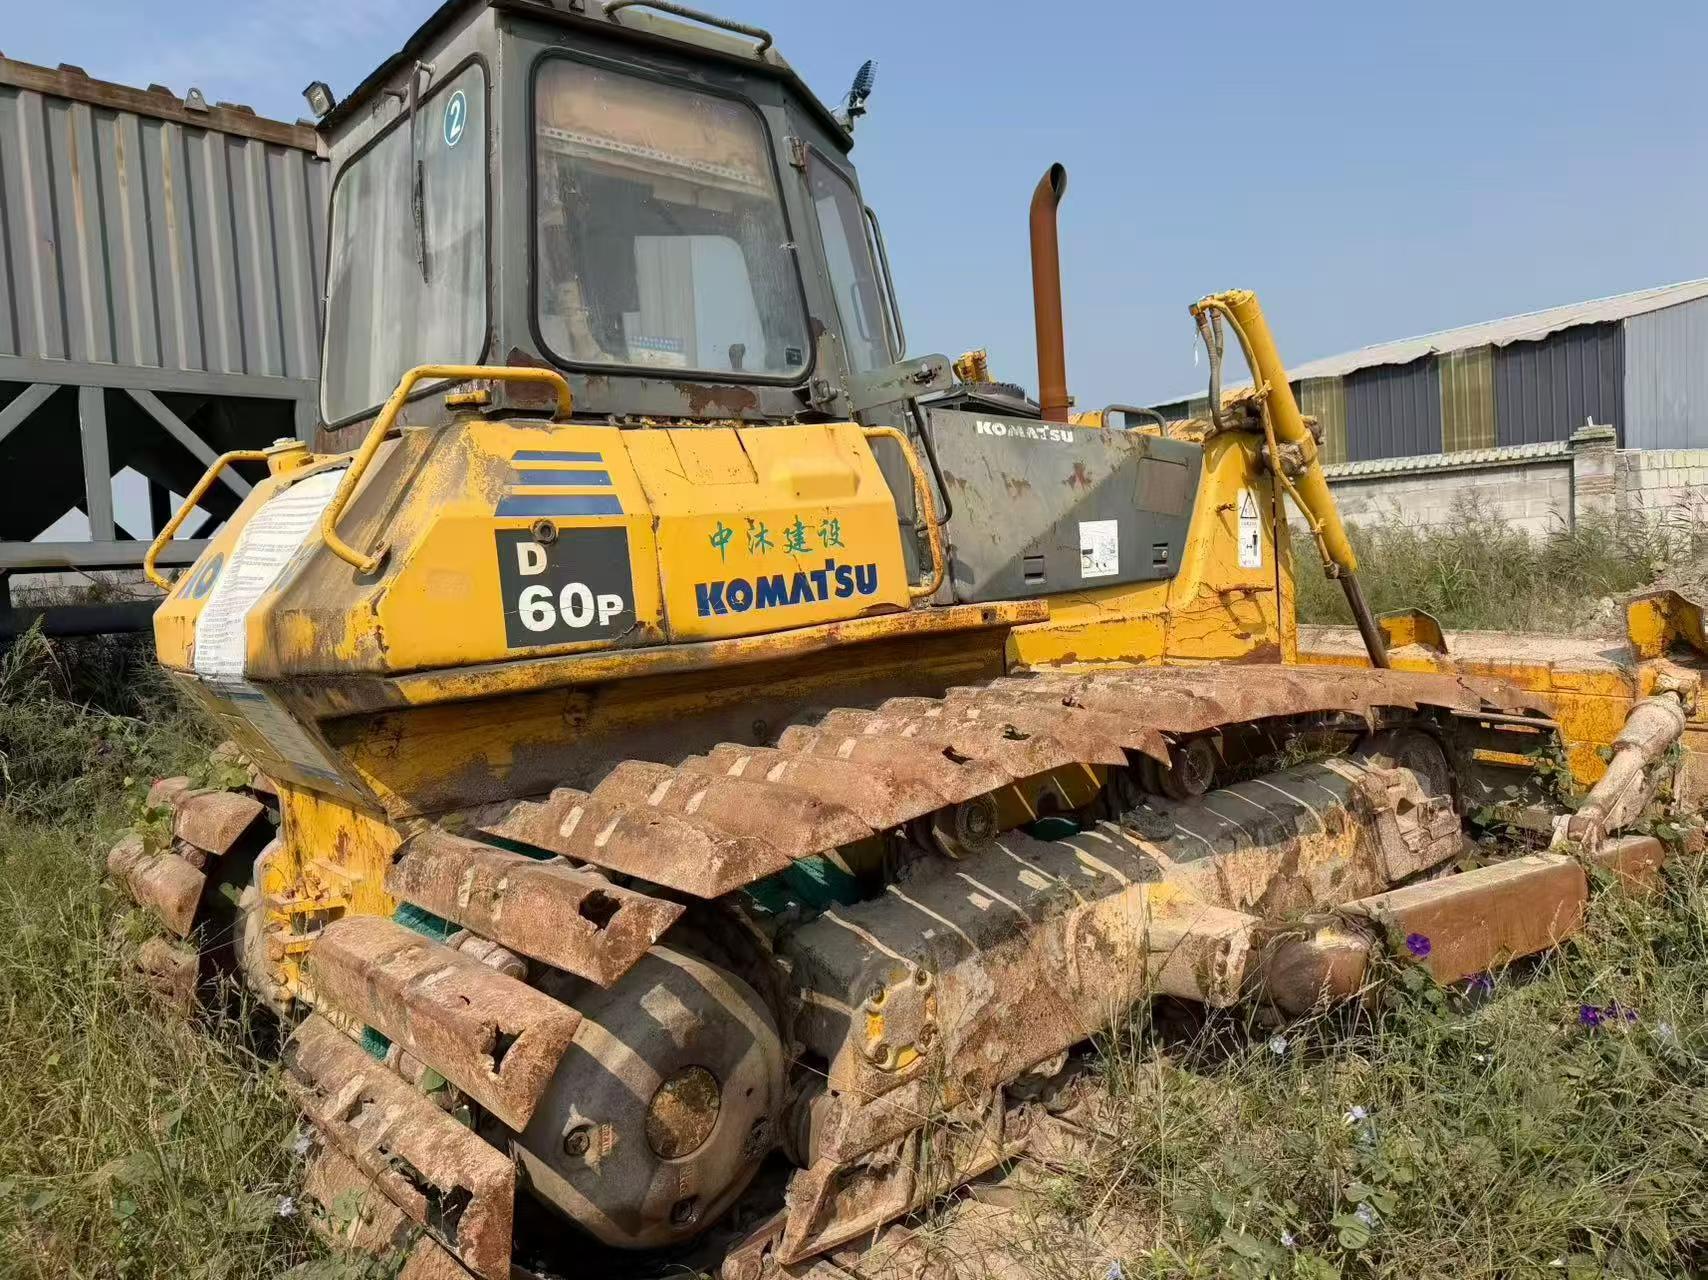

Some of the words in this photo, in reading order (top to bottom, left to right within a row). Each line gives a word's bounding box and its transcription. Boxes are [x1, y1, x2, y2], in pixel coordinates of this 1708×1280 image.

[450, 100, 461, 139] 2
[976, 419, 1074, 443] KOMATSU
[517, 542, 548, 576] D
[517, 582, 623, 632] 60P
[695, 558, 878, 617] KOMATSU
